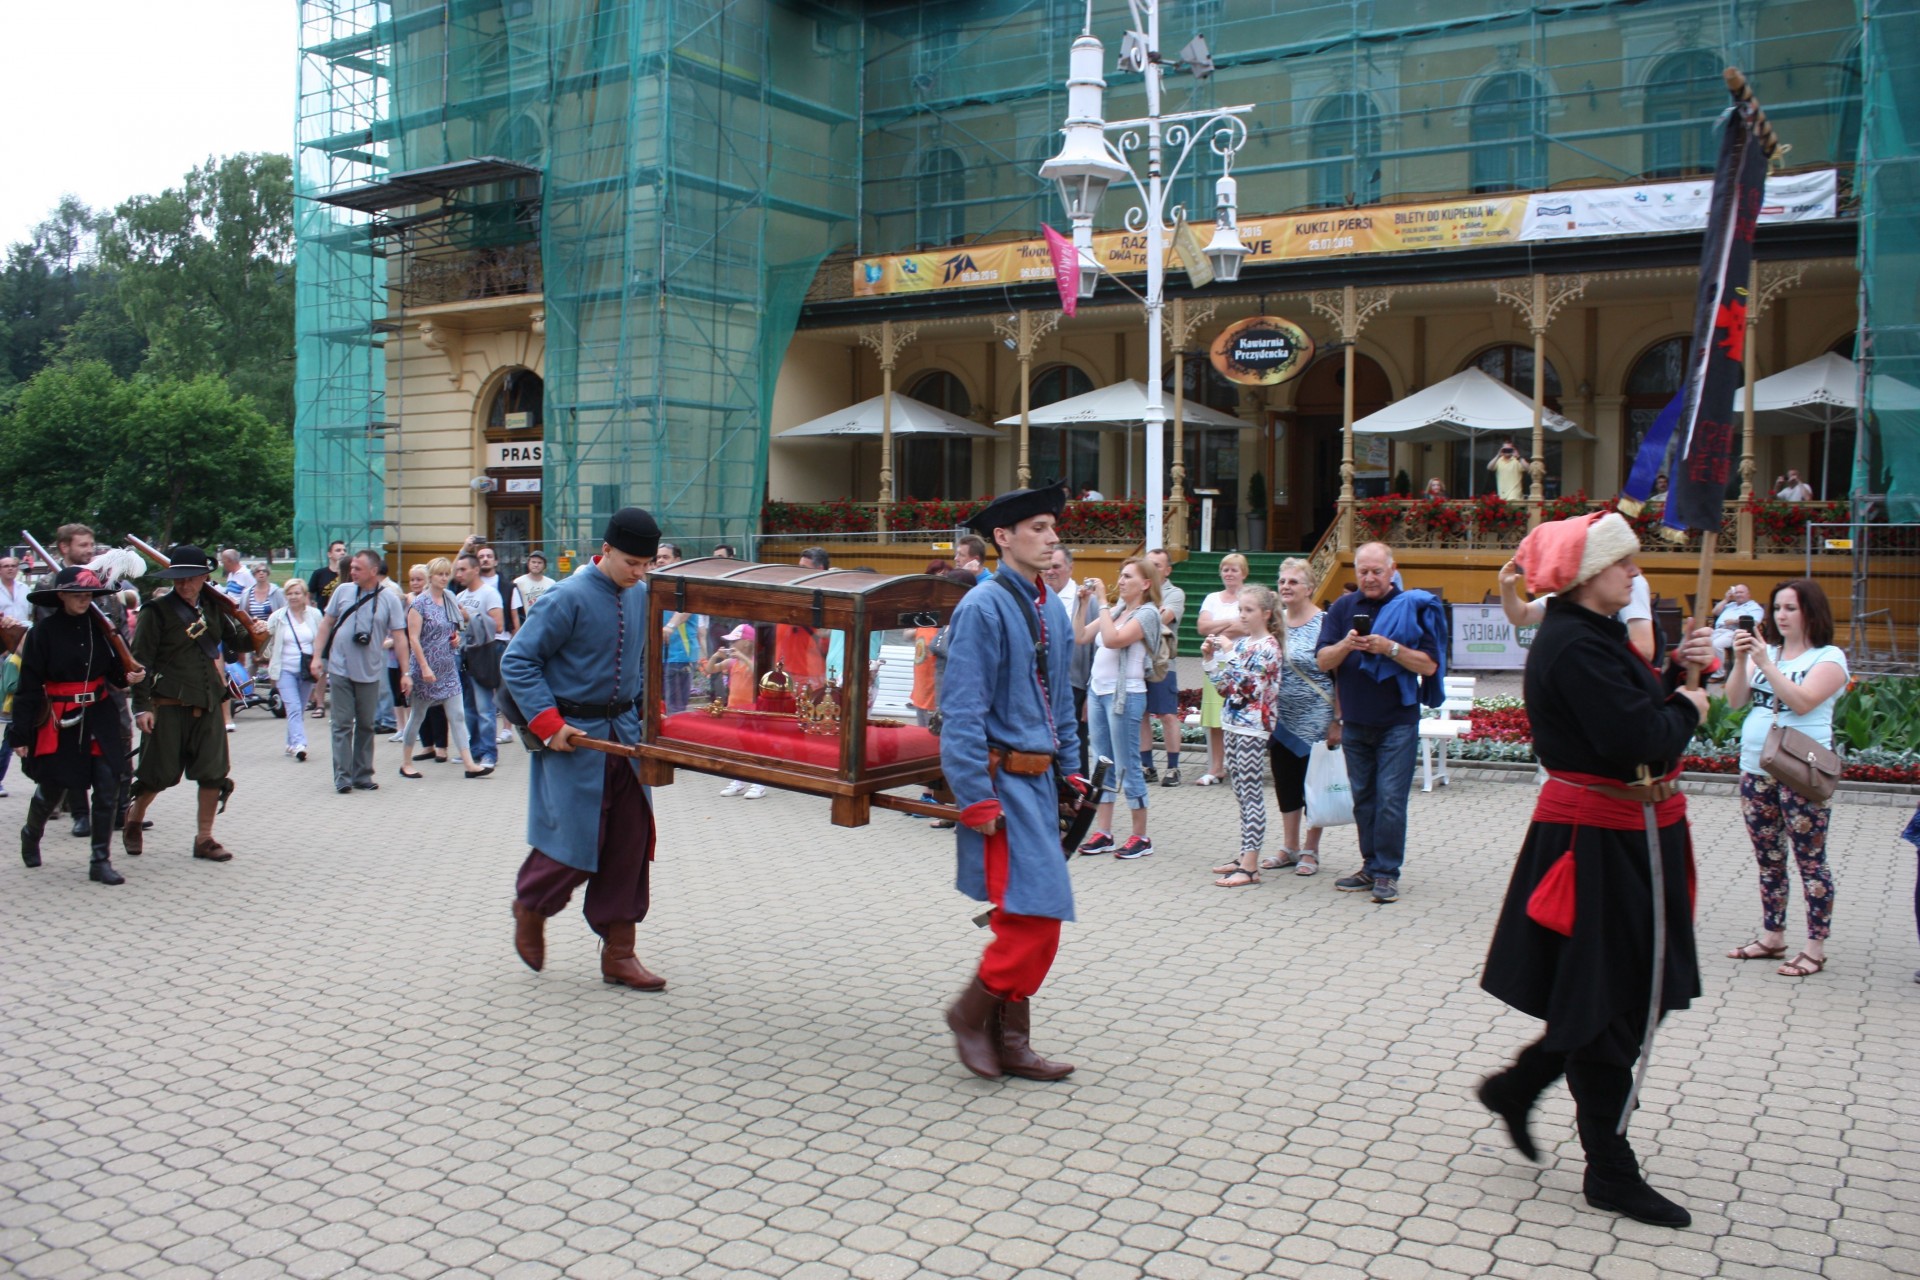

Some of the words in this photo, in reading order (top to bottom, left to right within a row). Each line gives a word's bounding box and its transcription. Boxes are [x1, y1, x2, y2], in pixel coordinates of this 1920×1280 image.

[1395, 211, 1424, 224] BILETY
[1427, 210, 1440, 221] DO
[1441, 206, 1483, 220] KUPIENIA
[1296, 221, 1329, 235] KUKIZ
[1331, 221, 1335, 231] I
[1338, 218, 1373, 231] PIERSI
[1121, 237, 1147, 249] RAZ
[1109, 250, 1131, 261] DWA
[1133, 254, 1147, 265] TR
[1239, 338, 1285, 349] Kawiarnia
[1235, 349, 1289, 361] Prezydencka
